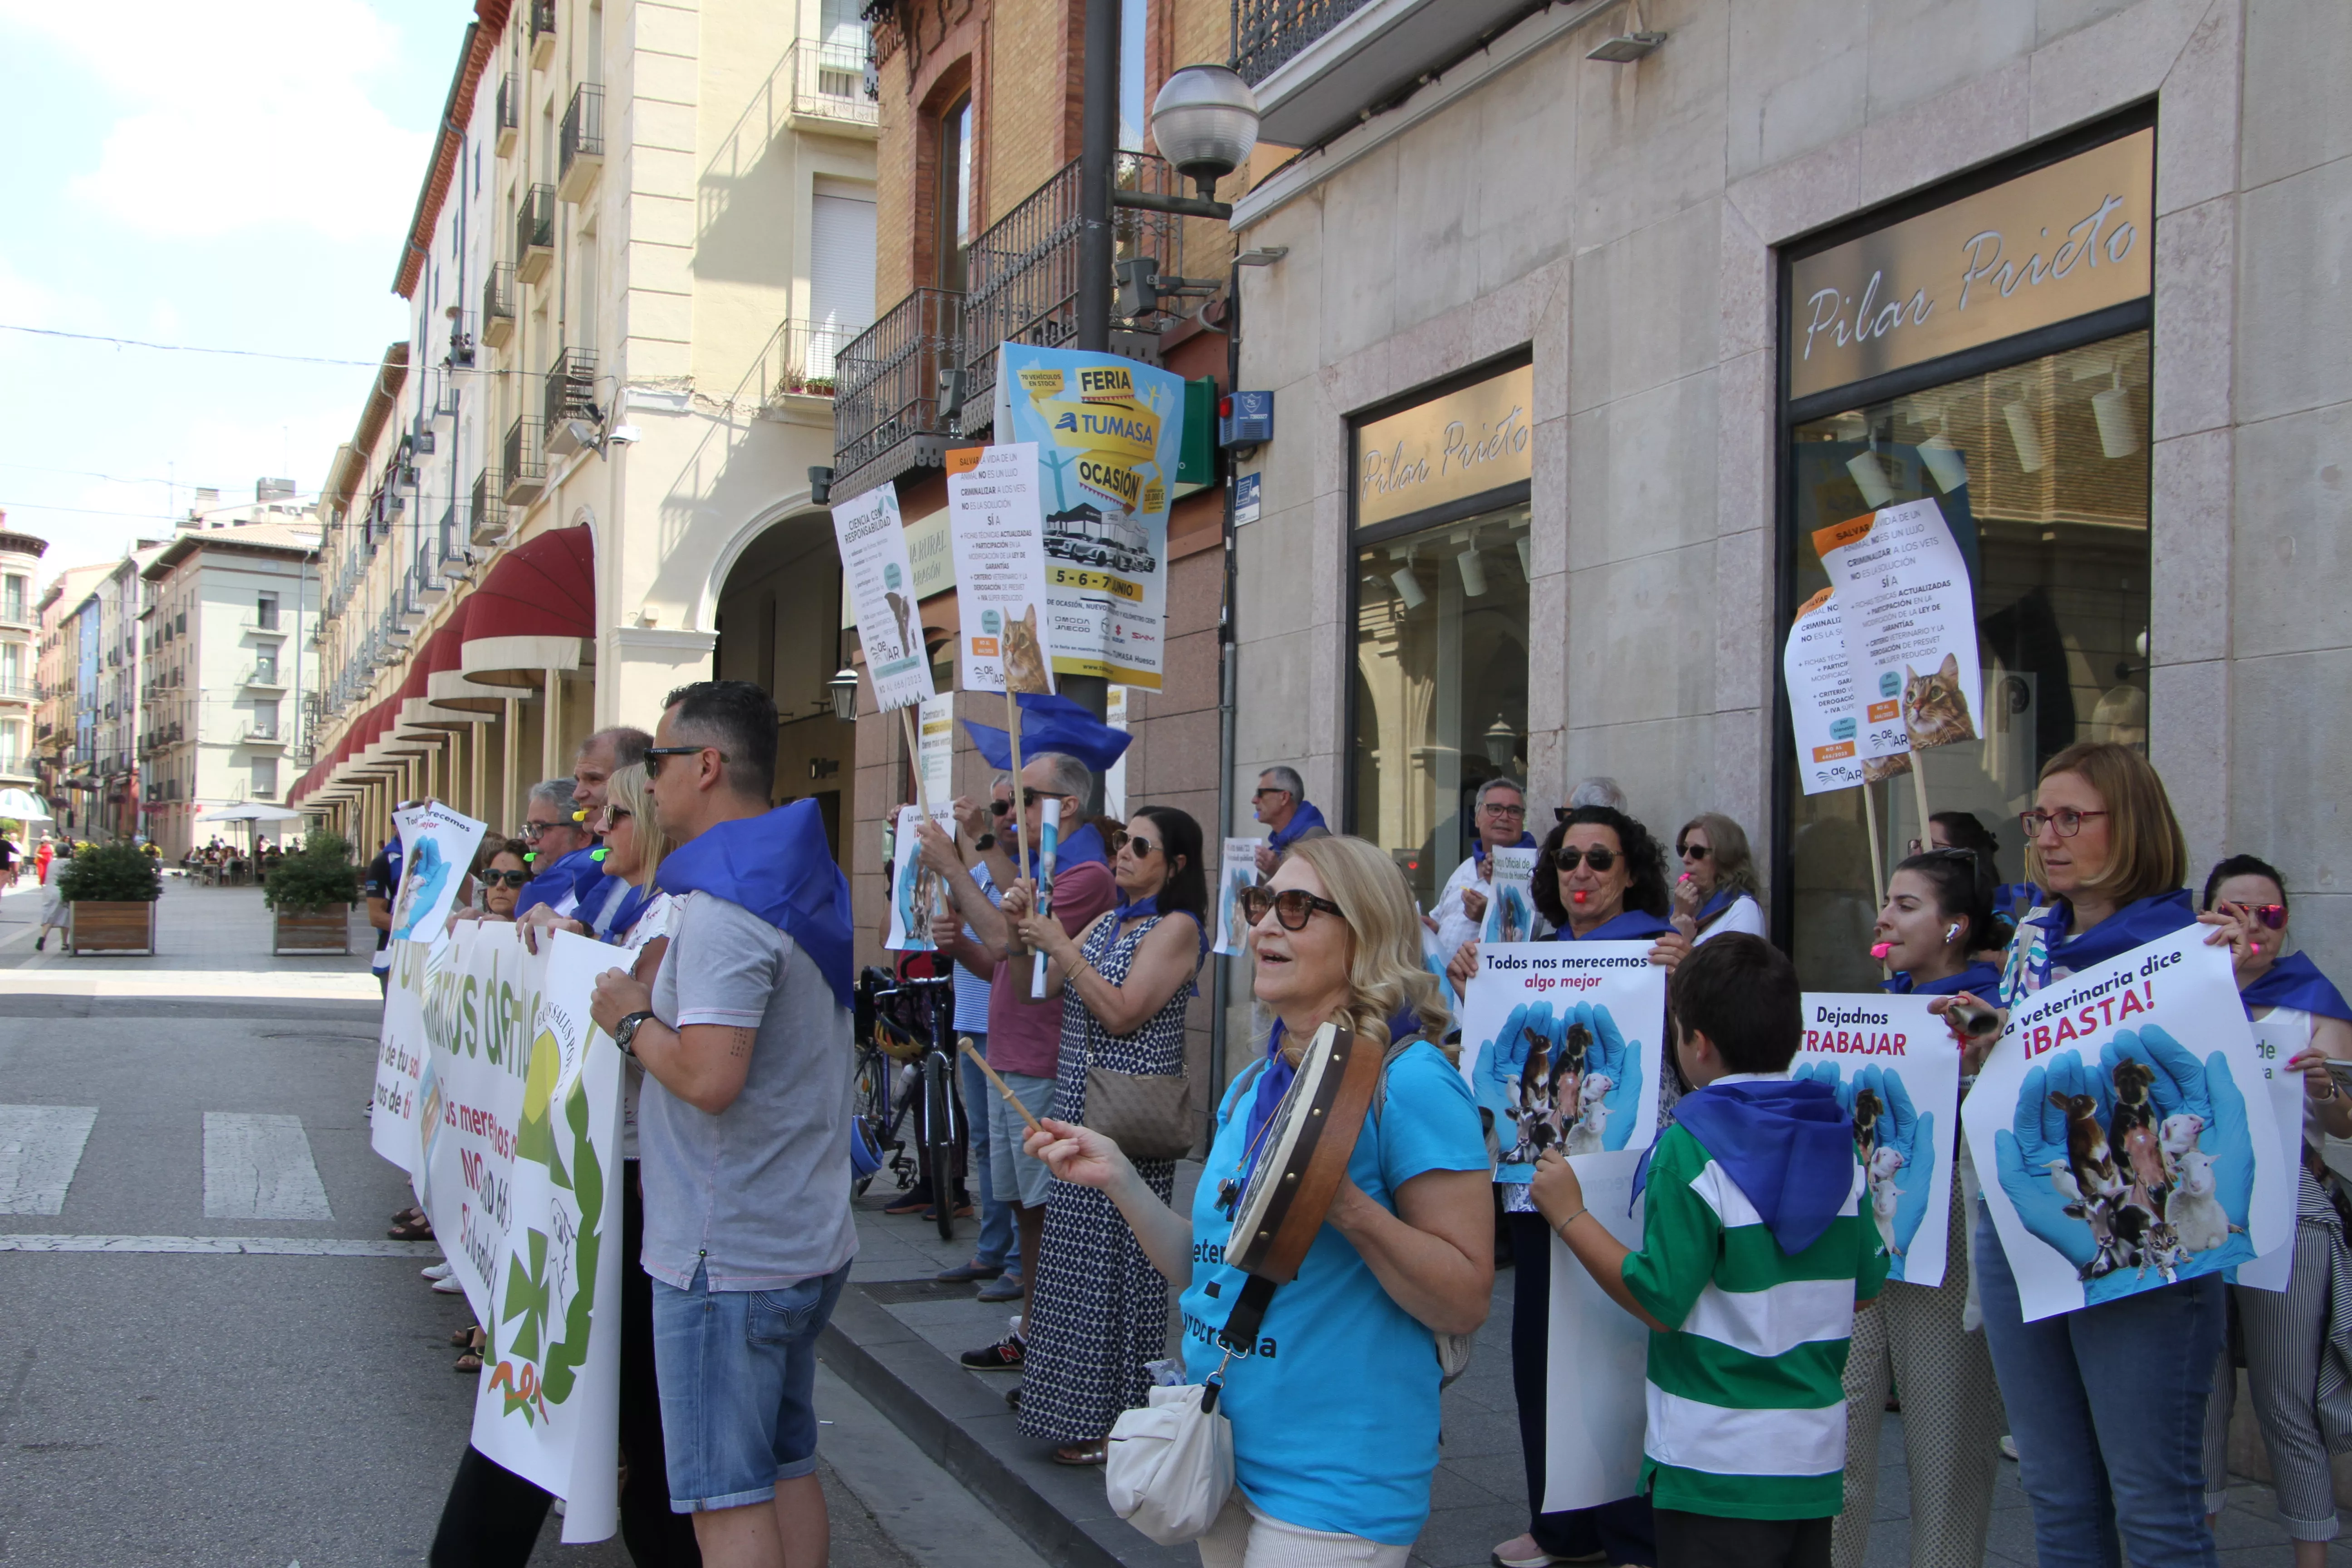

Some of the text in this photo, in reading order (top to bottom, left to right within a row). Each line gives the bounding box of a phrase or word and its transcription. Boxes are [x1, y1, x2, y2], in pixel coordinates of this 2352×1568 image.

[1804, 194, 2136, 360] Pilar Prieto
[1081, 371, 1131, 392] FERIA
[1082, 414, 1153, 446] TUMASA
[960, 457, 979, 466] SALVAR
[987, 454, 1000, 463] VIDA
[1001, 454, 1009, 462] DE
[1362, 405, 1529, 501] Pilar Prieto
[960, 472, 977, 480] ANIMAL
[979, 471, 986, 479] NO
[996, 470, 1004, 478] UN
[1005, 468, 1018, 477] LUJO
[1080, 461, 1140, 501] OCASIÓN
[961, 486, 996, 496] CRIMINALIZAR
[1002, 485, 1012, 493] LOS
[1014, 484, 1026, 492] VETS
[984, 500, 1011, 509] SOLUCIÓN
[849, 514, 870, 530] CIENCIA
[988, 513, 1000, 525] SÍ A
[1836, 510, 1921, 541] SALVAR VIDA DE UN
[845, 516, 891, 544] RESPONSABILIDAD
[1843, 523, 1925, 553] ANIMAL NO ES UN LUJO
[919, 530, 947, 562] RURAL
[976, 540, 1009, 549] PARTICIPACIÓN
[1847, 536, 1939, 568] CRIMINALIZAR A LOS VETS
[913, 560, 941, 586] ARAGÓN
[1850, 556, 1916, 581] NO ES LA SOLUCIÓN
[974, 582, 1001, 590] DEROGACIÓN
[1056, 570, 1133, 596] 5 6 7 JUNIO
[1882, 575, 1898, 588] SÍ A
[1898, 579, 1951, 597] ACTUALIZADAS
[1086, 603, 1107, 611] NUEVO
[1803, 608, 1826, 618] ANIMAL
[1871, 599, 1912, 614] PARTICIPACIÓN
[1914, 597, 1923, 605] EN
[1898, 609, 1907, 618] DE
[1918, 604, 1930, 614] LEY
[1055, 616, 1090, 625] OMODA
[1882, 619, 1914, 632] GARANTÍAS
[1870, 636, 1889, 647] CRITERIO
[1889, 627, 1930, 643] VETERINARIO
[1870, 636, 1940, 657] DEROGACIÓN DE PRESVET
[1112, 651, 1133, 662] TUMASA
[1135, 653, 1156, 666] Huesca
[1901, 647, 1937, 659] REDUCIDO
[879, 686, 886, 694] NO
[894, 674, 922, 689] 666/2023
[1819, 689, 1847, 698] CRITERIO
[1818, 694, 1854, 707] DEROGACIÓ
[304, 702, 313, 755] HOSTAL
[1882, 729, 1892, 739] ae
[1831, 766, 1846, 776] ae
[908, 813, 913, 822] La
[1505, 857, 1520, 868] Oficial
[1522, 858, 1530, 869] de
[1486, 955, 1648, 970] Todos nos merecemos
[1525, 973, 1603, 992] algo mejor
[2020, 970, 2134, 1027] veterinaria
[2140, 950, 2183, 978] dice
[552, 1004, 574, 1040] SALUS
[1817, 1006, 1888, 1028] Dejadnos
[2022, 980, 2156, 1061] ¡BASTA!
[1797, 1030, 1906, 1056] TRABAJAR
[386, 1034, 408, 1073] de tu
[388, 1081, 412, 1120] de ti
[461, 1147, 483, 1195] NO
[998, 1343, 1021, 1362] N
